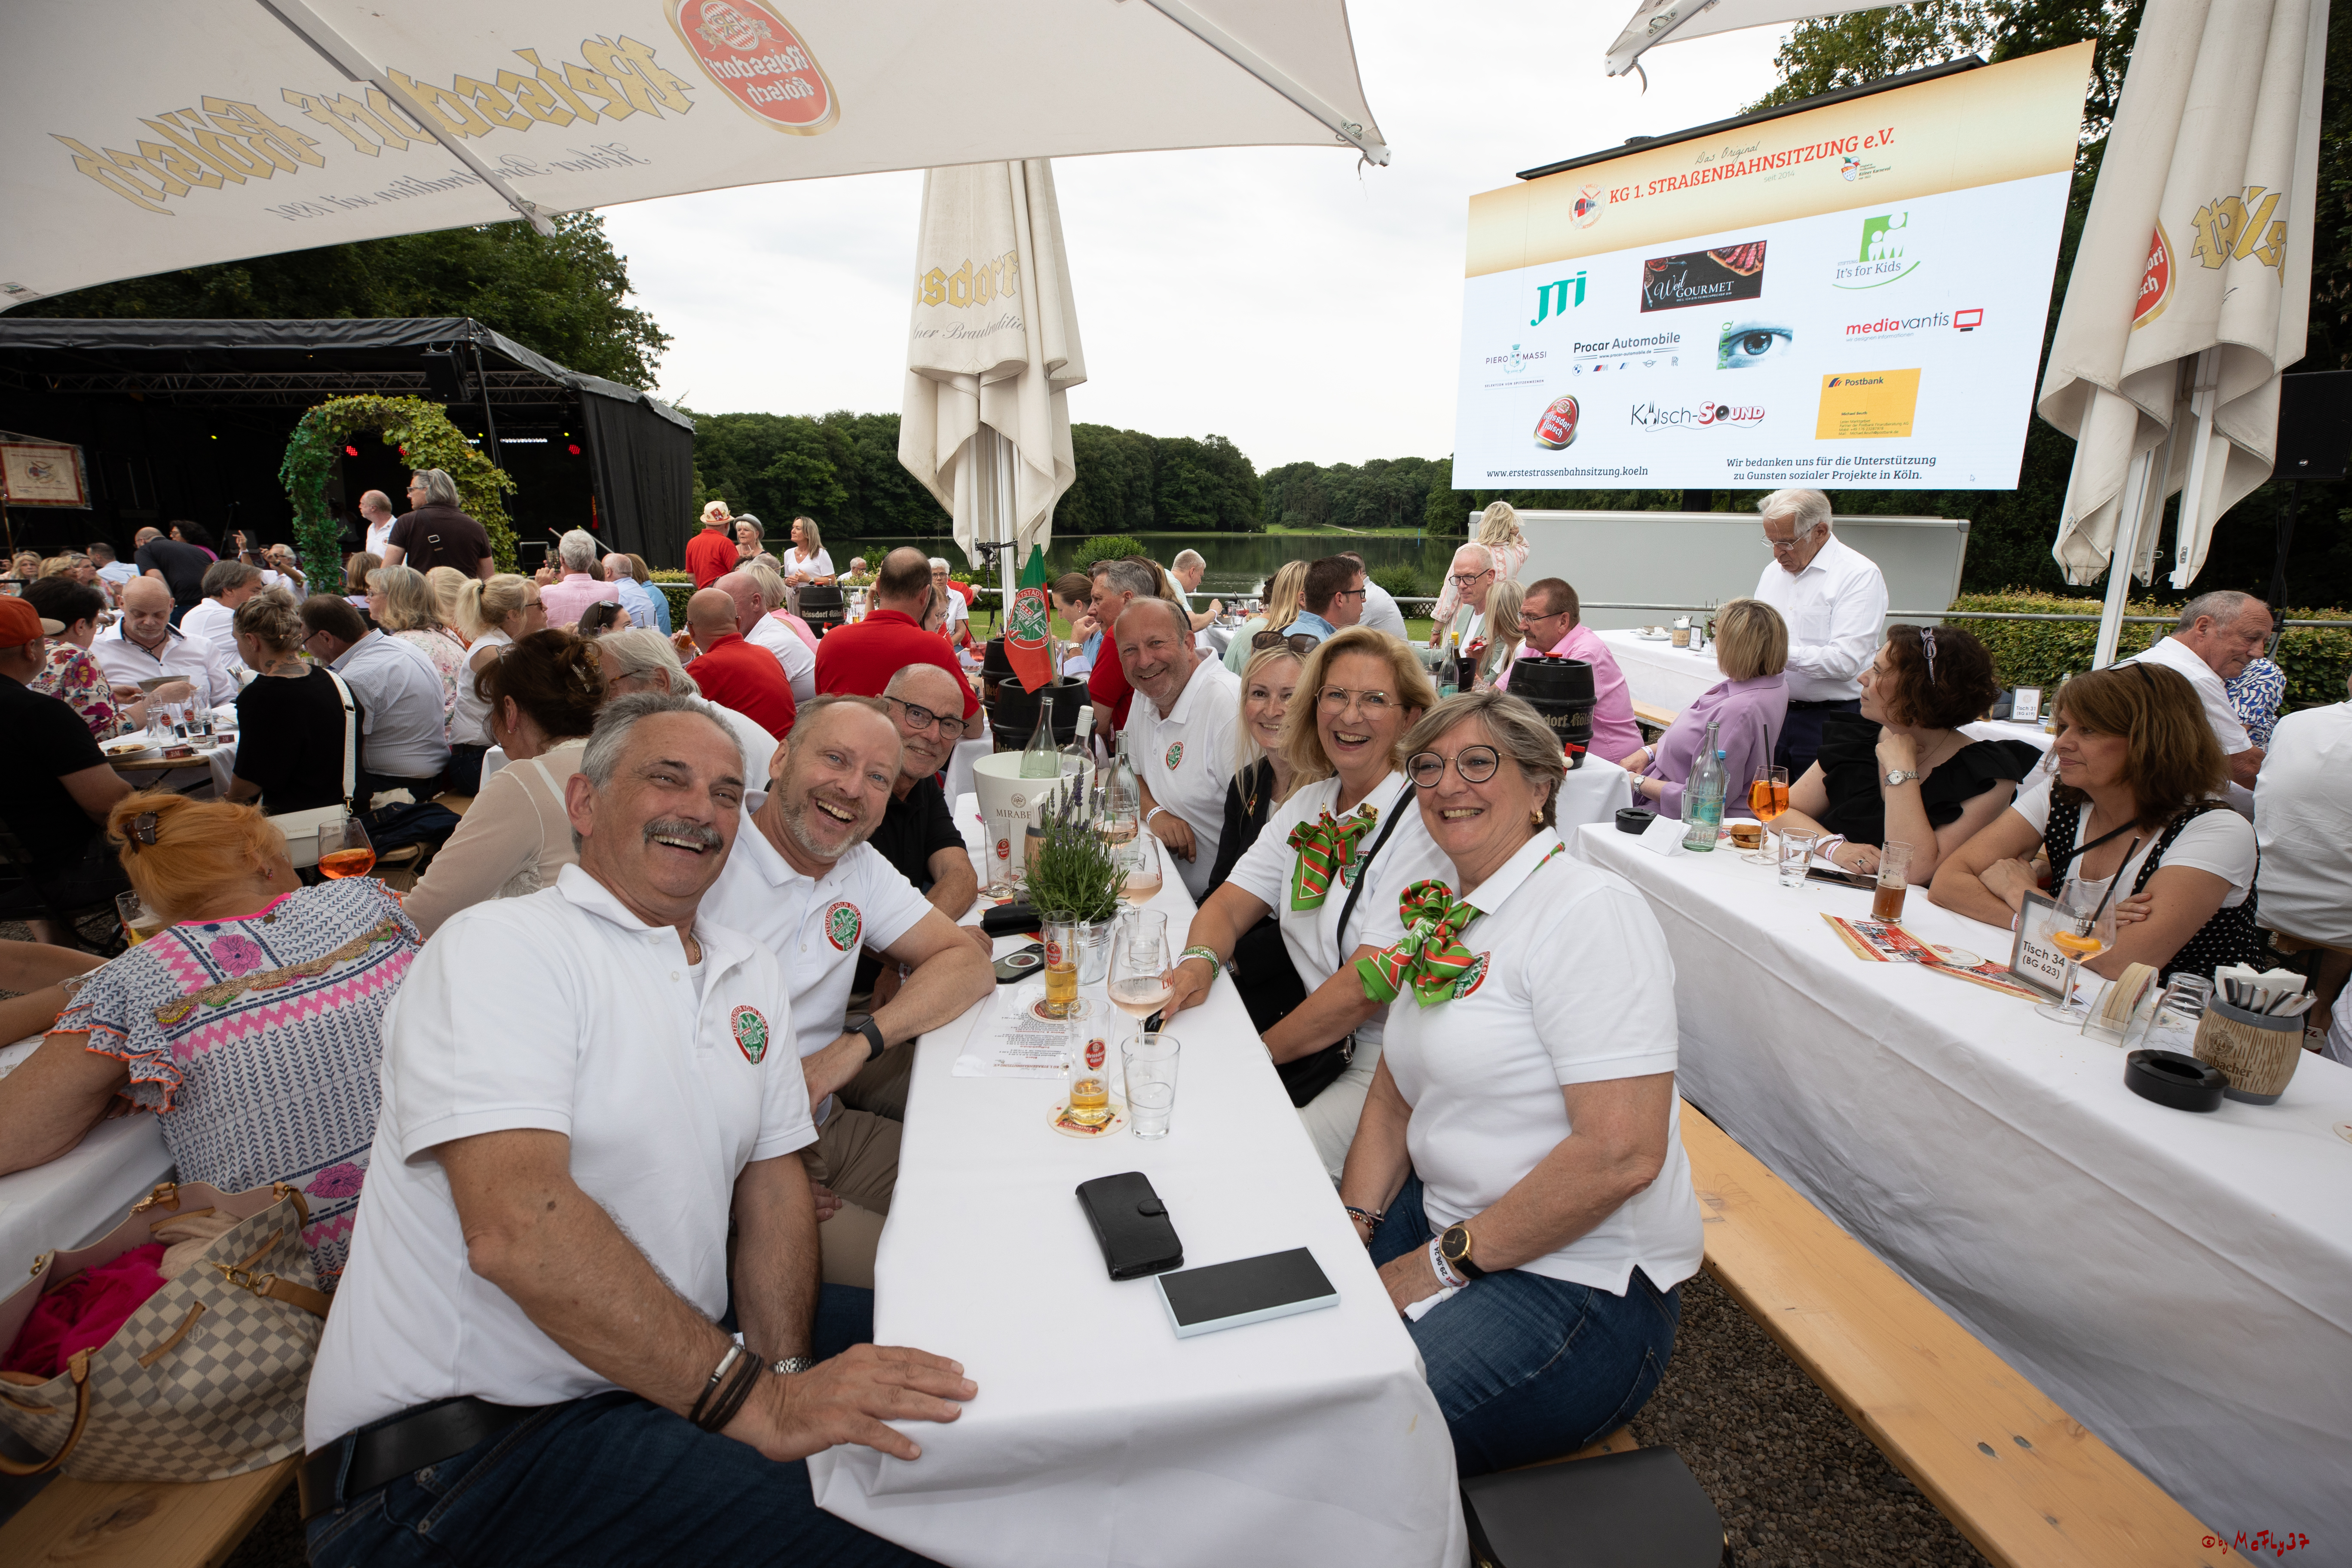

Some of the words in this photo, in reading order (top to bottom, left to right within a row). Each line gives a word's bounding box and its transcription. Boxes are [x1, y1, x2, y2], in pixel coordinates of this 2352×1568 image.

[1695, 151, 1715, 165] Das
[1721, 141, 1761, 164] Original
[1609, 187, 1630, 204] KG
[1634, 185, 1644, 199] 1.
[1648, 135, 1859, 196] STRAßENBAHNSITZUNG
[1863, 127, 1895, 150] e.V.
[1764, 174, 1776, 183] seit
[1778, 170, 1795, 180] 2014
[1855, 265, 1873, 277] for
[1874, 261, 1901, 274] Kids
[1654, 270, 1688, 300] Weil
[1676, 281, 1735, 298] GOURMET
[1846, 312, 1950, 335] mediavantis
[1574, 340, 1610, 354] Procar
[1611, 332, 1681, 349] Automobile
[1878, 332, 1914, 340] informationen
[1485, 355, 1509, 364] PIERO
[1522, 351, 1547, 360] MASSI
[1599, 349, 1651, 358] www.procar-automobile.de
[1845, 377, 1884, 386] Postbank
[1543, 412, 1572, 432] Reissdorf
[1543, 420, 1563, 438] Kölsch
[1727, 458, 1744, 467] Wir
[1746, 458, 1793, 467] bedanken
[1815, 456, 1833, 466] für
[1835, 456, 1852, 466] die
[1853, 456, 1937, 467] Unterstützung
[1487, 466, 1648, 478] www.erstestrassenbahnsitzung.koeln
[1746, 471, 1787, 481] Gunsten
[1789, 471, 1830, 481] sozialer
[1831, 470, 1877, 482] Projekte
[1879, 470, 1891, 480] in
[1893, 469, 1923, 480] Köln.
[2023, 940, 2049, 960] Tisch
[2052, 954, 2065, 967] 34
[2022, 955, 2039, 968] (BG
[2041, 964, 2060, 980] 623)
[2194, 1044, 2253, 1078] Krombacher
